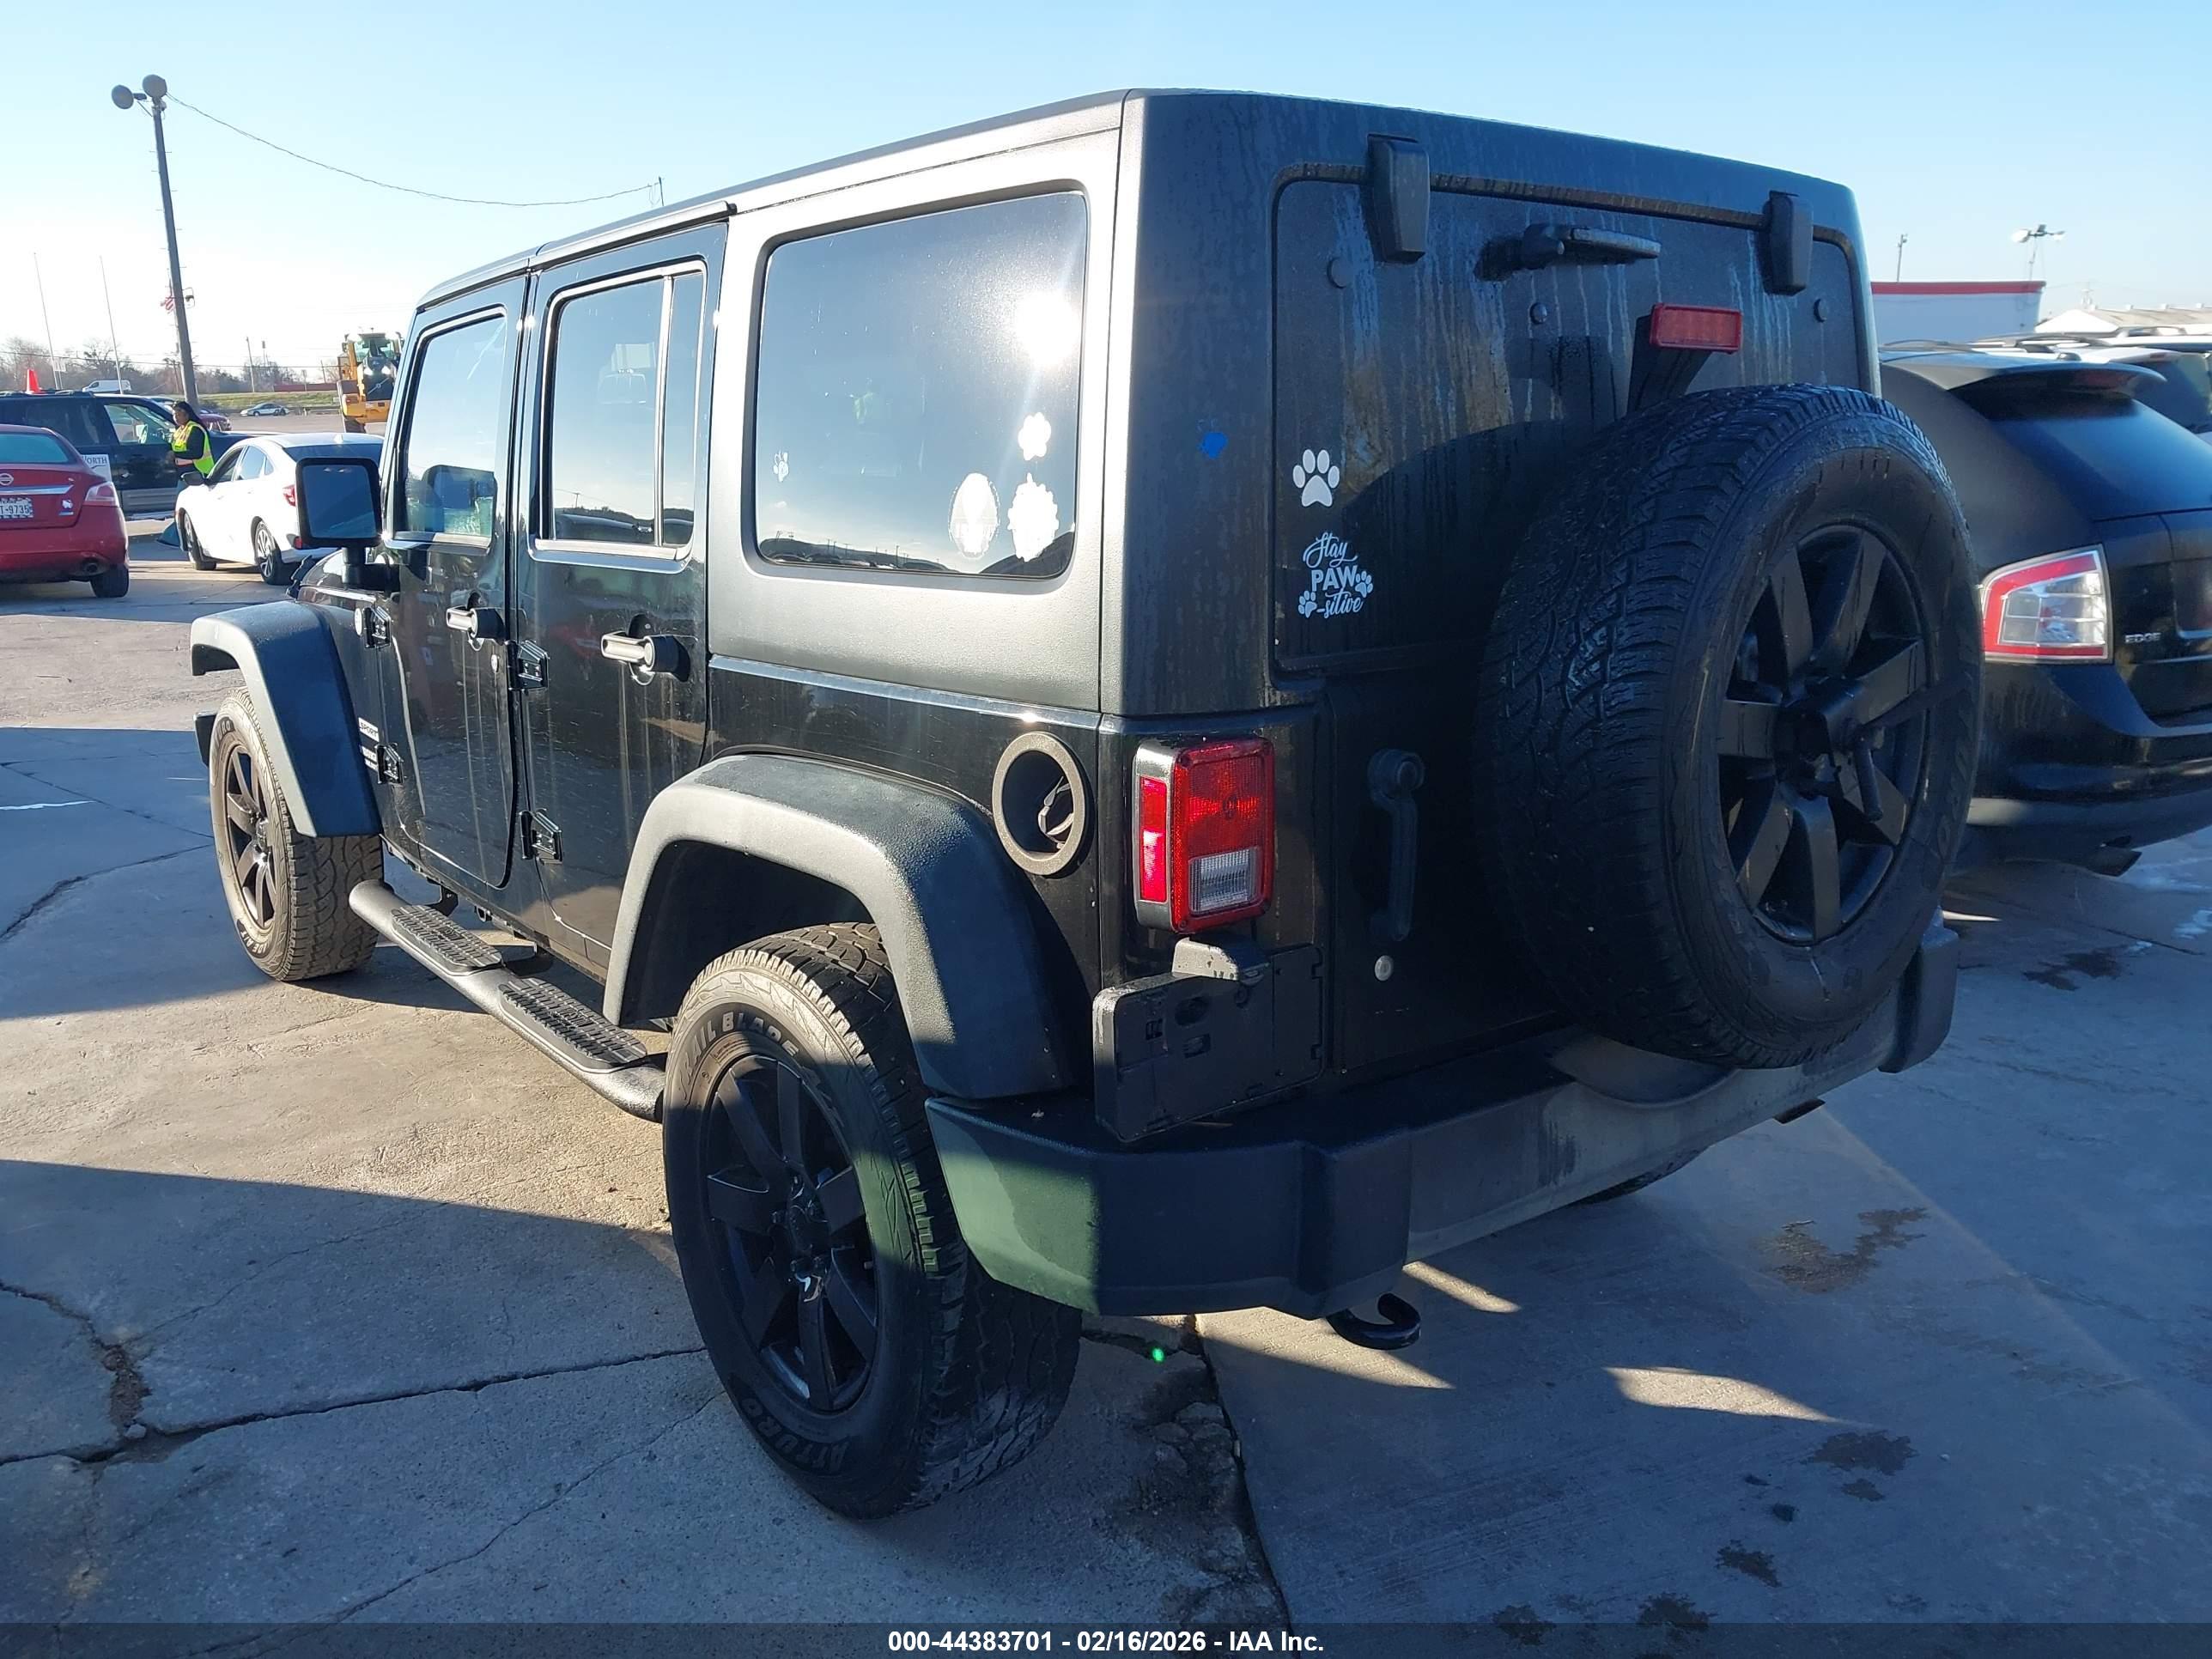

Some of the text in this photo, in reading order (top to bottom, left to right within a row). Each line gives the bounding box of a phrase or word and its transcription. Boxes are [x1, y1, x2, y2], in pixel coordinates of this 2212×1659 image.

[1304, 532, 1358, 568] Stay
[1311, 565, 1358, 592] PAW
[2125, 632, 2162, 644] EDGE
[360, 722, 379, 738] SPORT
[722, 1012, 799, 1057] BLADE
